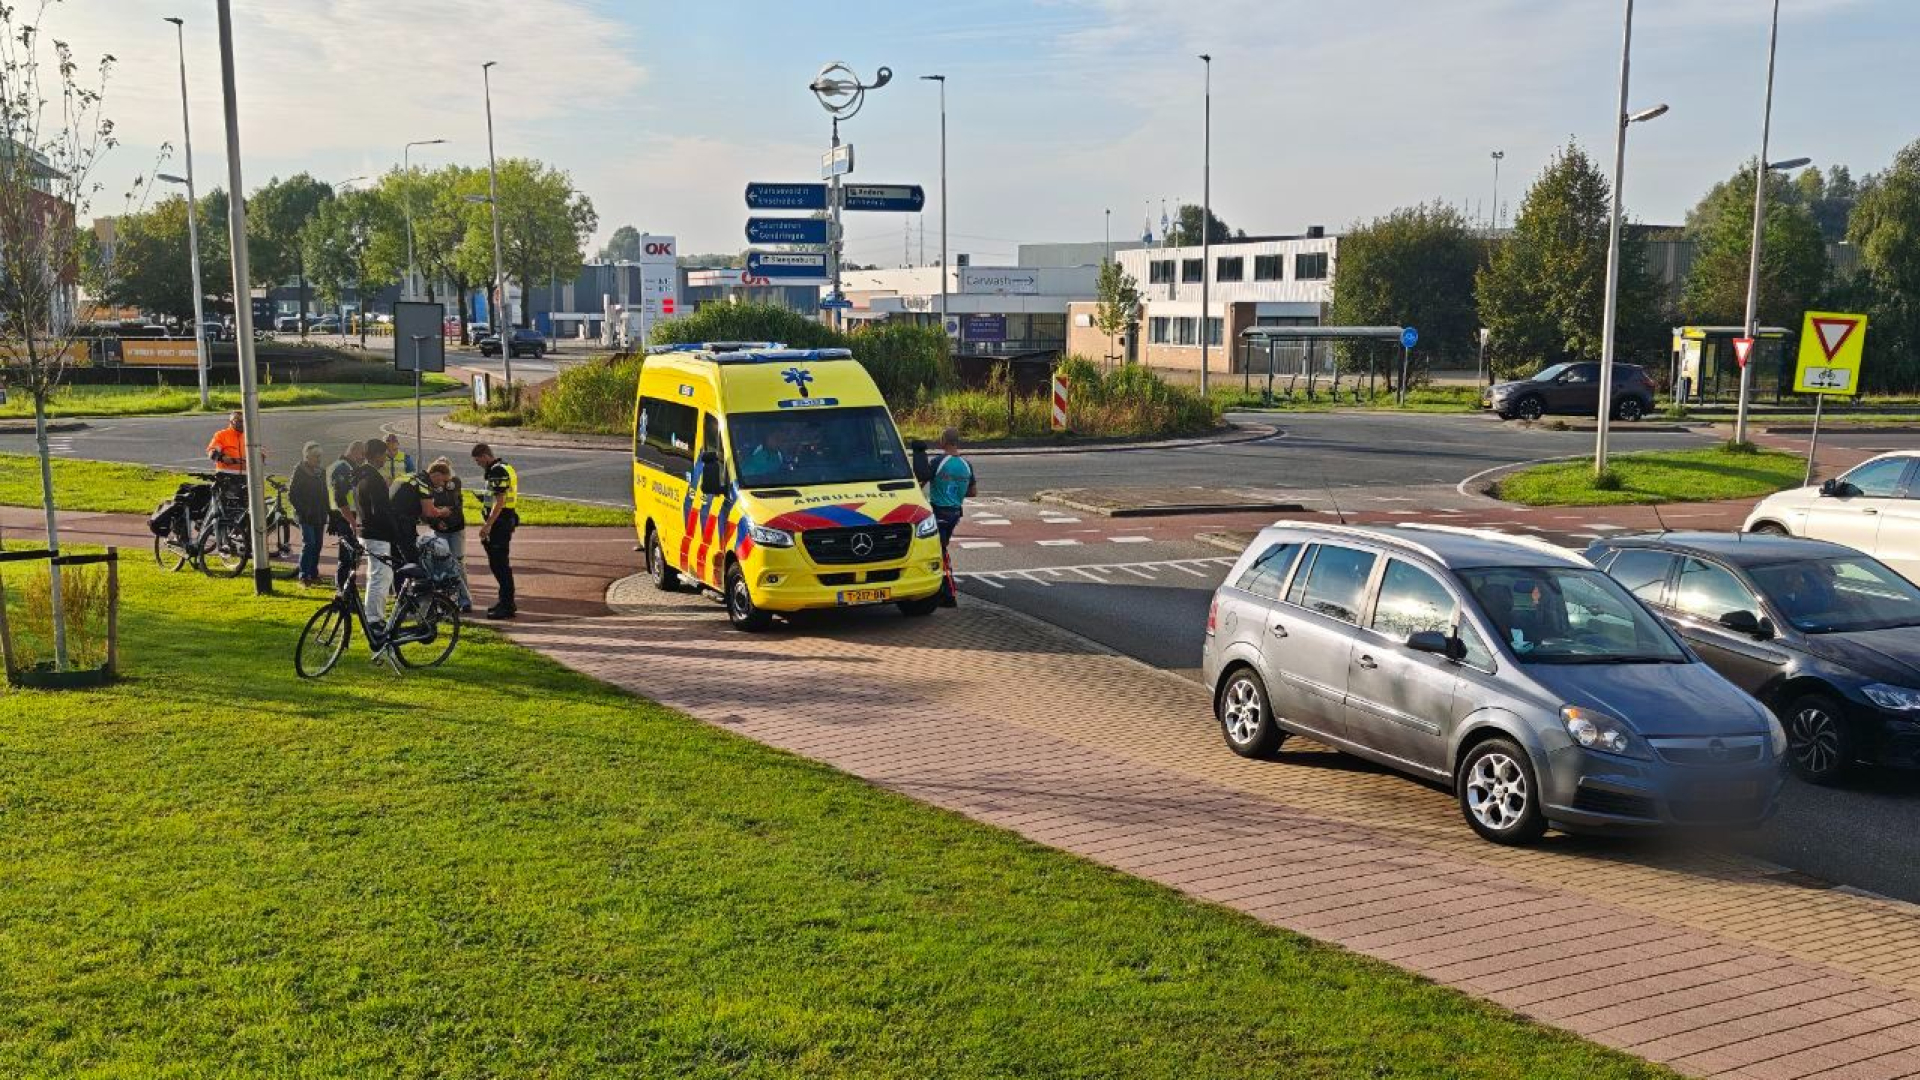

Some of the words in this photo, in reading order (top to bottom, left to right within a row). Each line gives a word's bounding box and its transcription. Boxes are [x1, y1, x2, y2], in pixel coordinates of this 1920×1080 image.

[645, 242, 672, 255] OK
[966, 275, 1011, 286] Carwash
[794, 492, 896, 505] AMBULANCE
